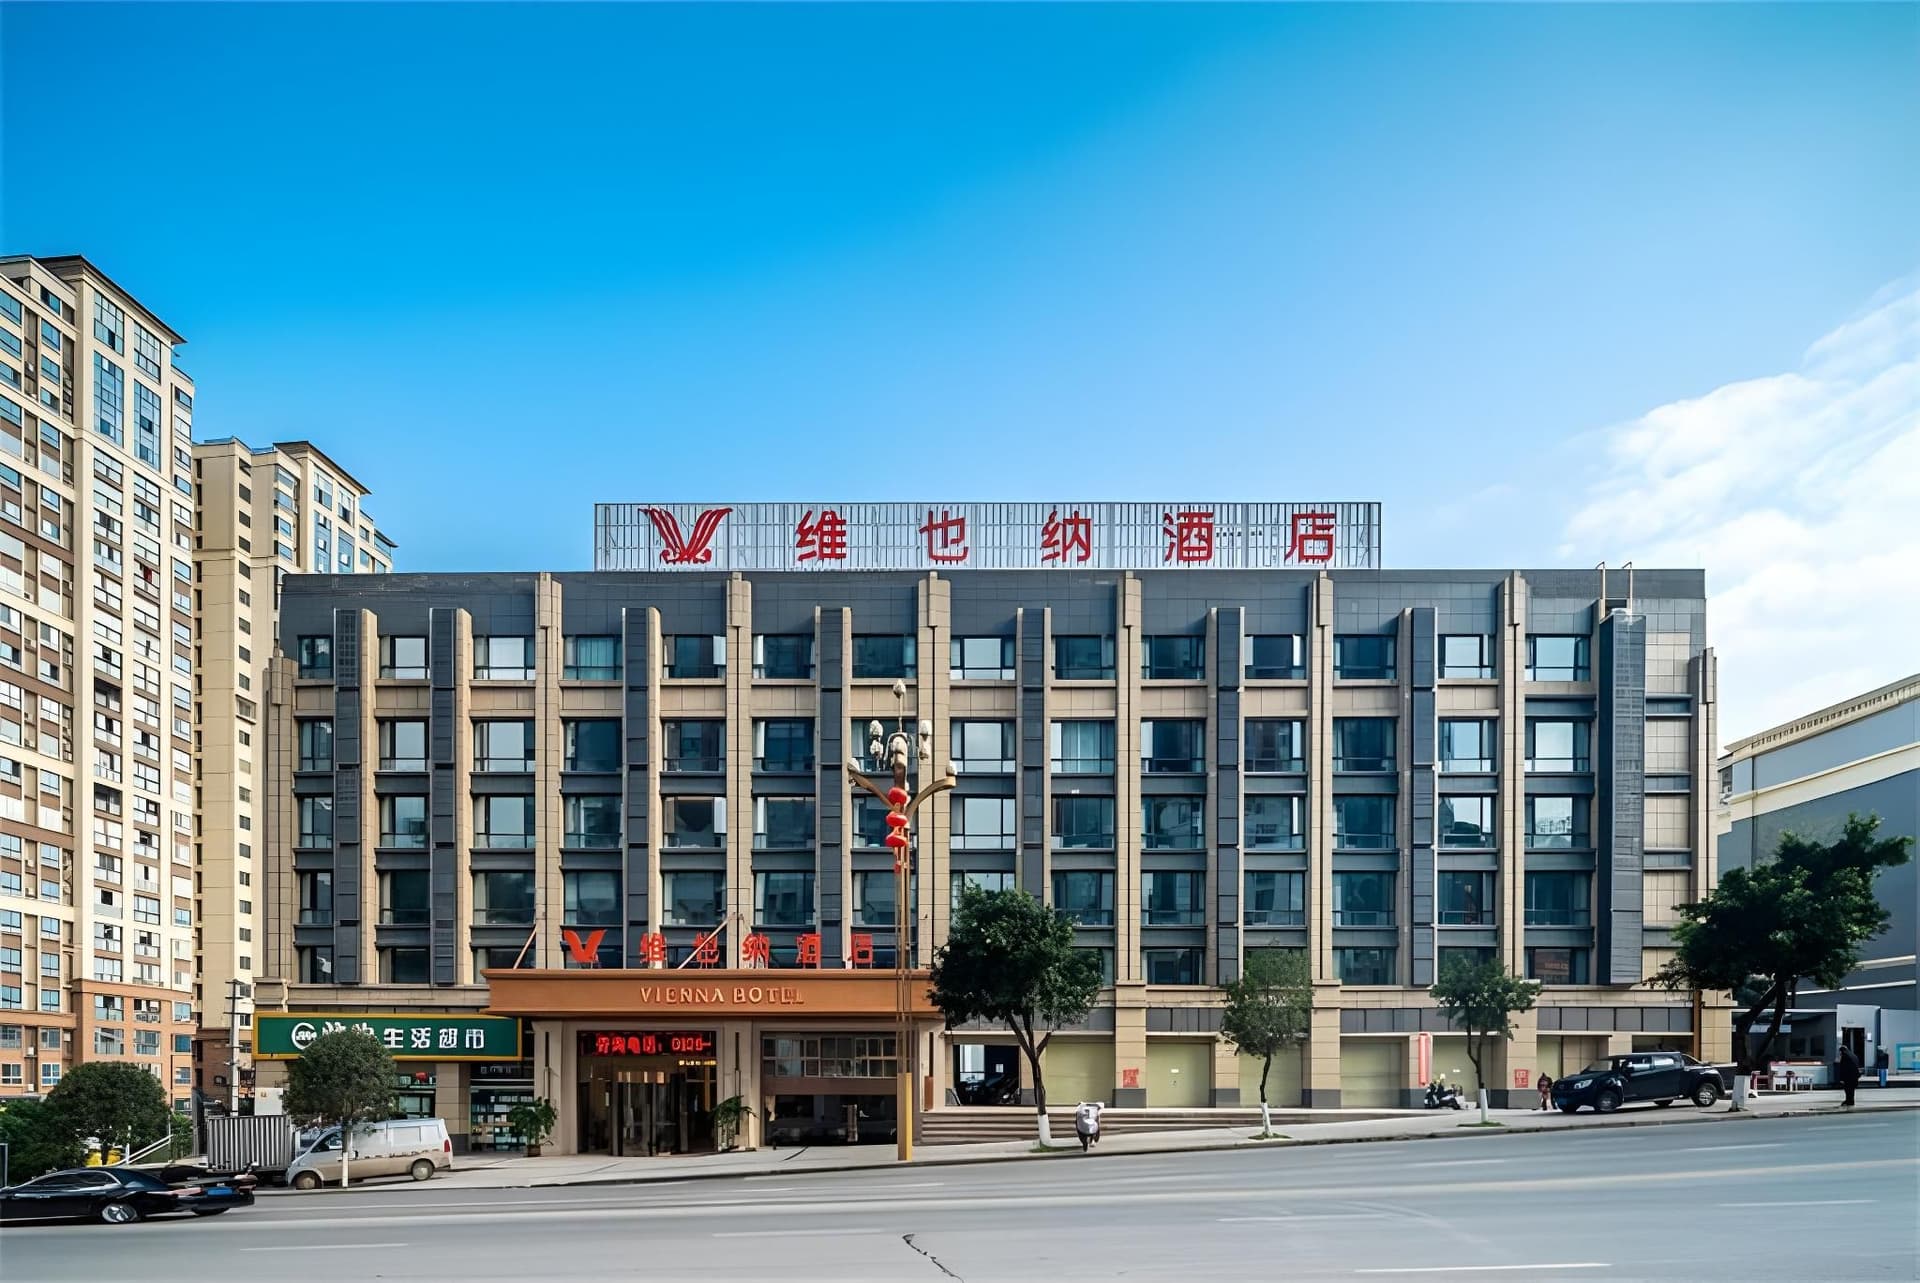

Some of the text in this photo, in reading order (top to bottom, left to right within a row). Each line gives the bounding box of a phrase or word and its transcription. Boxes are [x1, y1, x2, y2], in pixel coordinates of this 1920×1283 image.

[795, 510, 1336, 562] 维也纳酒店
[640, 986, 725, 1004] VIENNA
